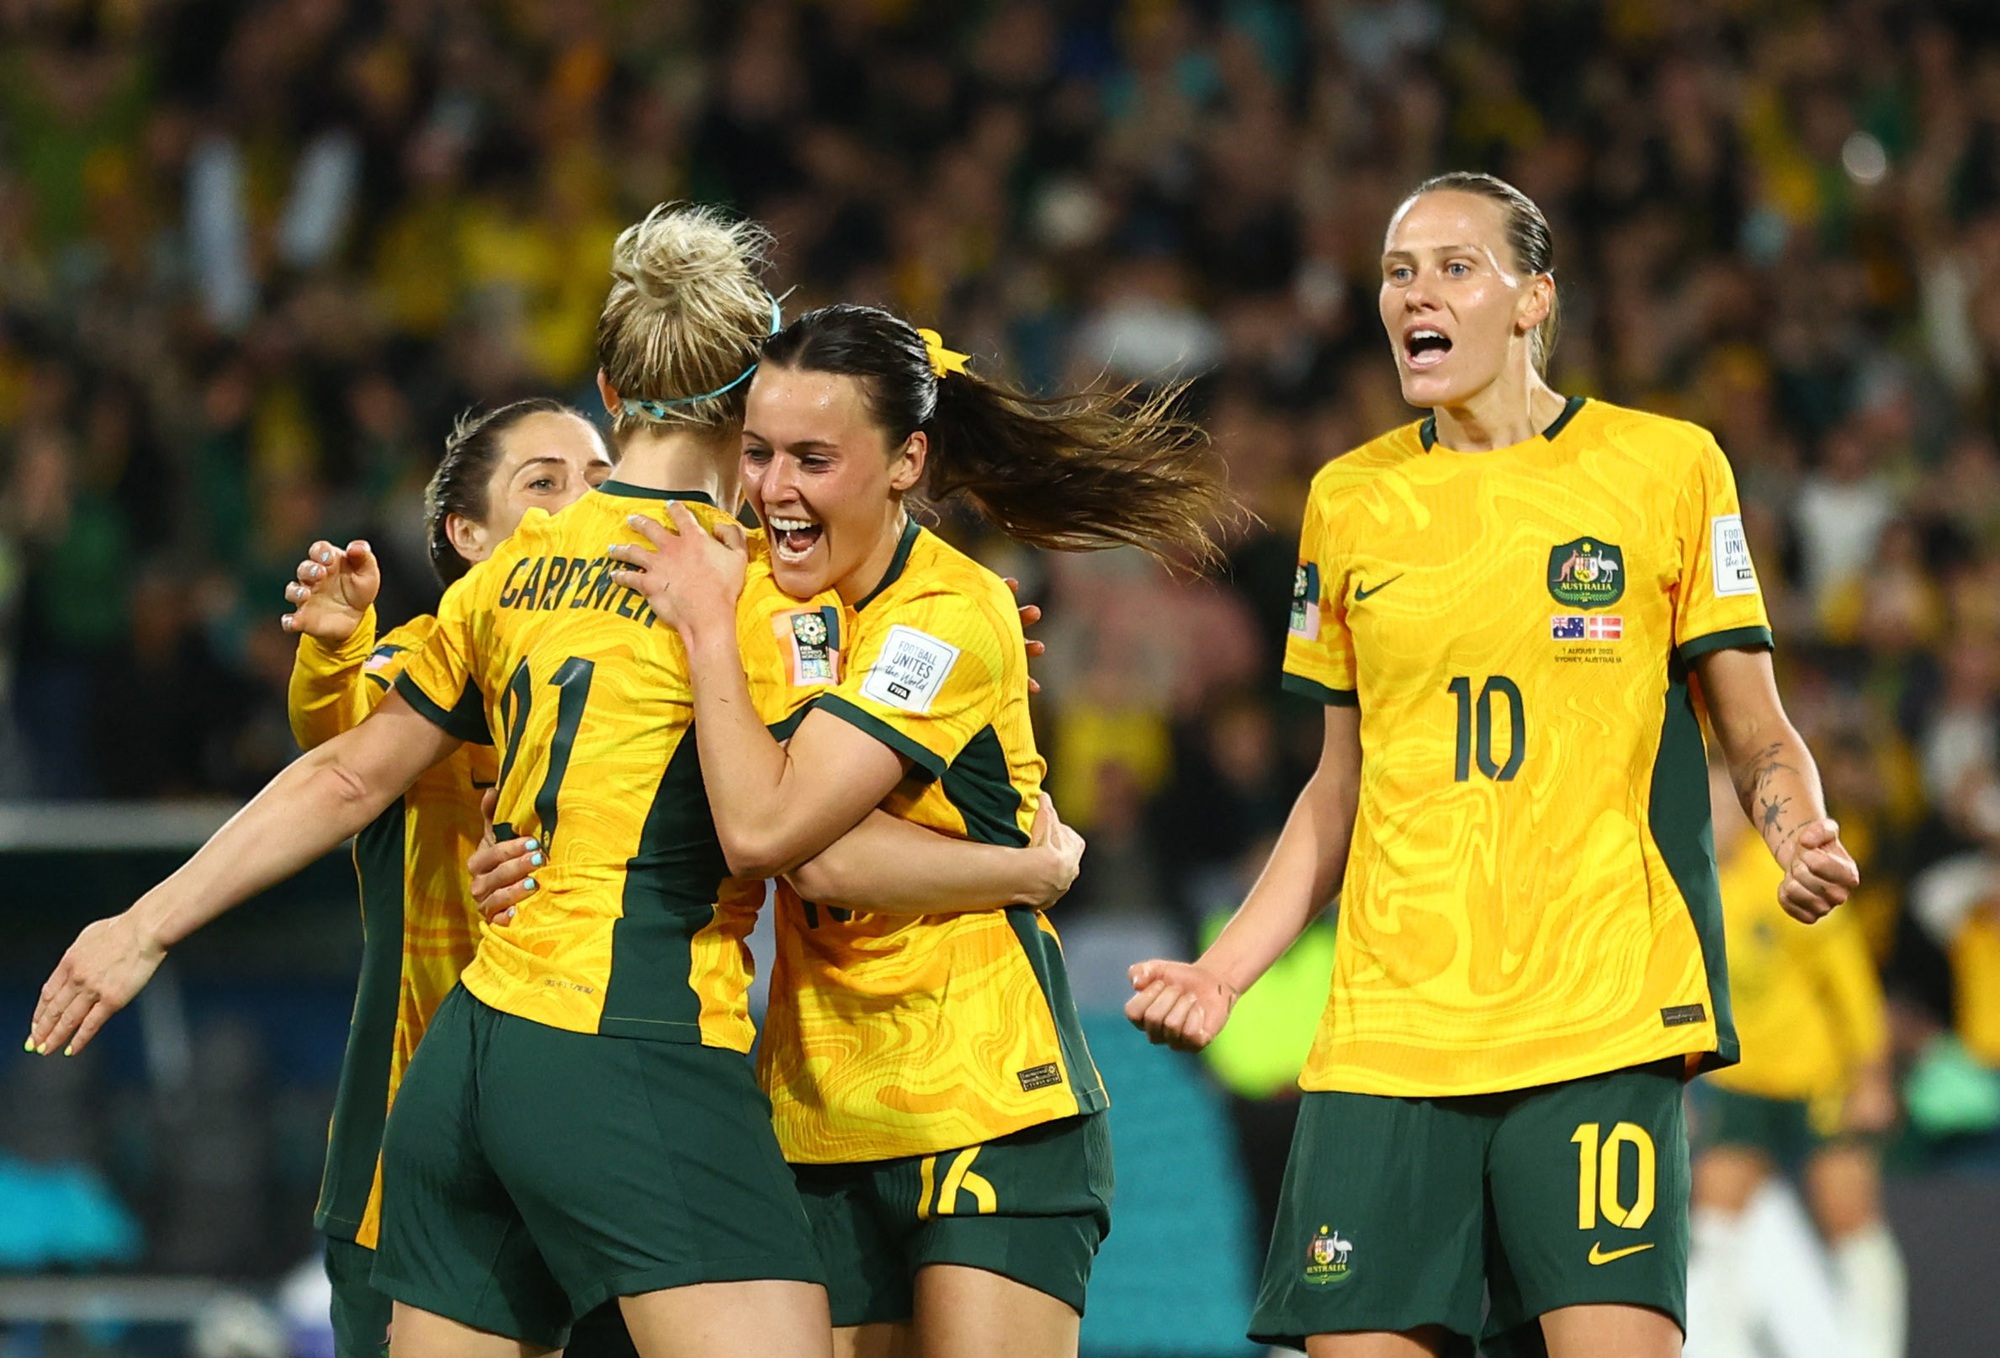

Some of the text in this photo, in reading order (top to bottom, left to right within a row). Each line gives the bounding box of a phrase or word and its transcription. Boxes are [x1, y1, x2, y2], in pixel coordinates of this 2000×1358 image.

[1561, 582, 1612, 591] AUSTRALIA
[899, 641, 938, 666] FOOTBALL
[1568, 647, 1596, 655] AUGUST
[892, 651, 933, 679] UNITES
[884, 665, 929, 693] the World
[890, 684, 908, 698] FIFA
[1447, 675, 1525, 781] 10
[1570, 1122, 1656, 1229] 10
[1306, 1264, 1346, 1273] USTRALIA
